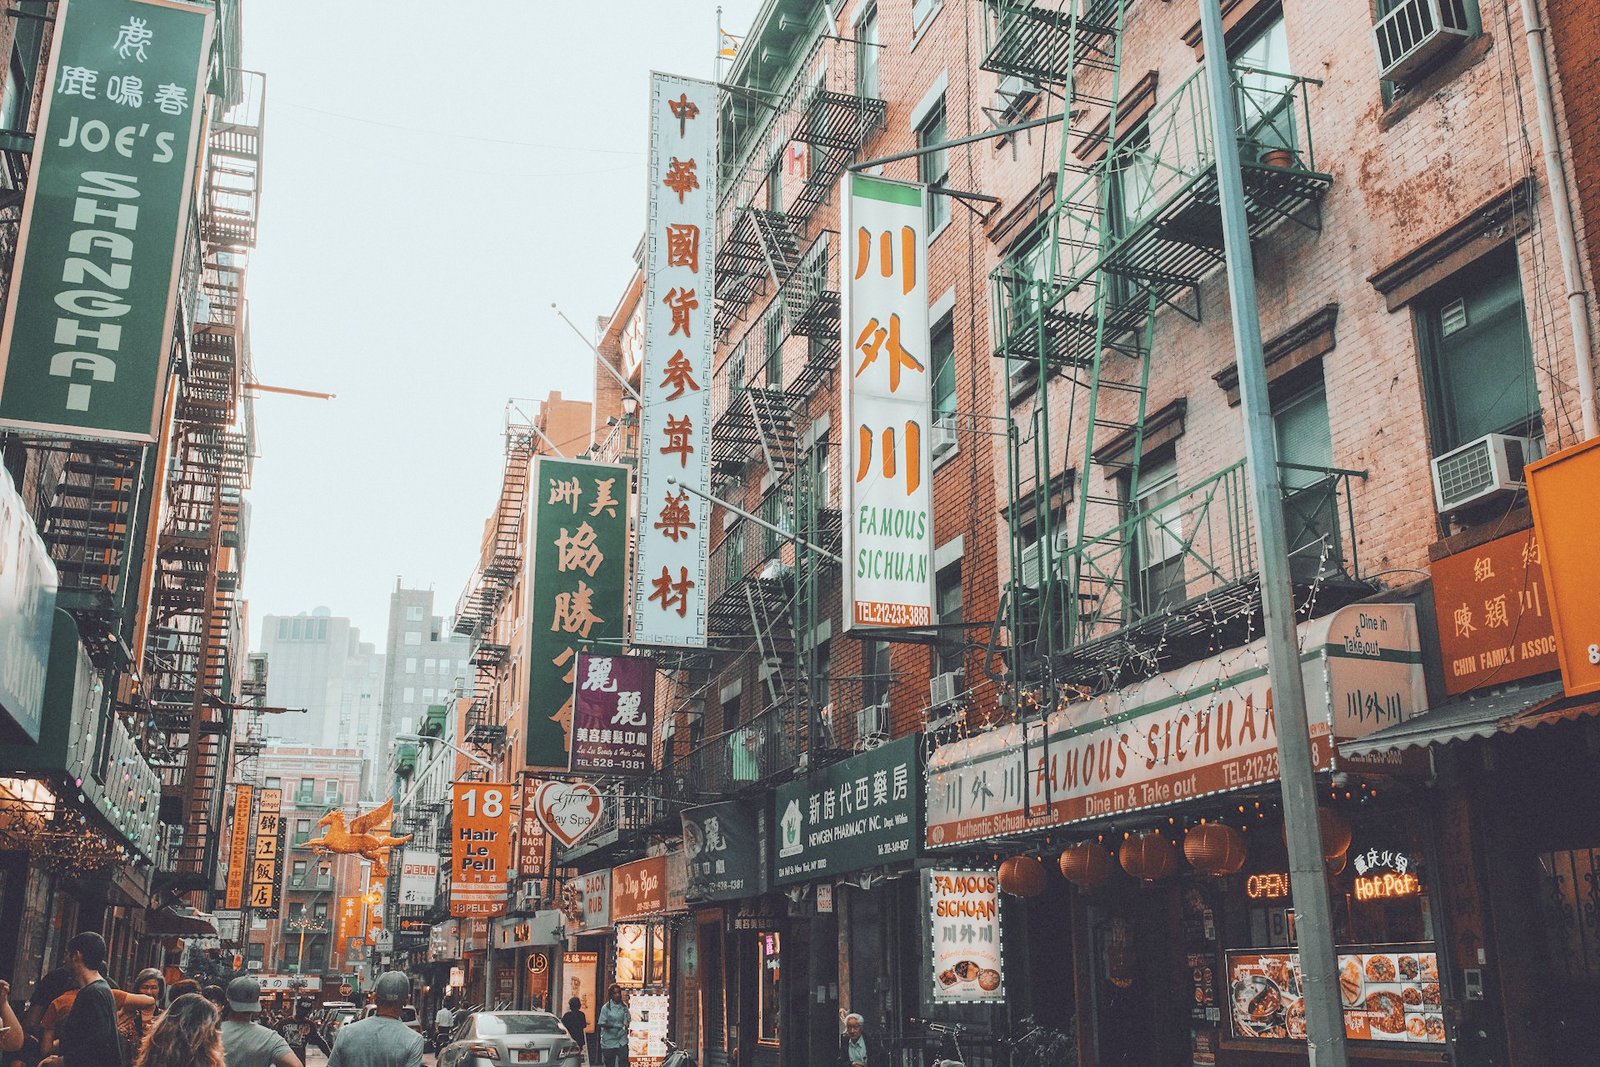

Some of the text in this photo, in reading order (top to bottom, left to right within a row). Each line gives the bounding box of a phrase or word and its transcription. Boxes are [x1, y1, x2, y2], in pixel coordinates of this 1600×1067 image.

[57, 65, 189, 117] 鹿鳴春
[58, 116, 175, 164] JOE'S
[49, 170, 142, 412] SHANGHAI
[854, 225, 924, 495] 川外川
[858, 505, 927, 541] FAMOUS
[857, 548, 928, 584] SICHUAN
[1355, 625, 1362, 638] &
[1359, 613, 1388, 631] Dine in
[1452, 635, 1557, 677] CHIN FAMILY ASSOC
[1346, 689, 1402, 724] 川外川
[1036, 733, 1129, 797] FAMOUS
[264, 791, 278, 800] Joe's
[809, 762, 908, 826] 新時代西藥房
[945, 760, 1023, 817] 川外川
[1085, 774, 1197, 816] Dine in & Take out
[261, 800, 280, 809] Ginger
[461, 788, 503, 818] 18
[546, 813, 591, 827] Day Spa
[955, 819, 993, 840] Authentic
[460, 828, 499, 841] Hair
[522, 837, 544, 846] BACK
[808, 828, 833, 847] NEWGEN
[834, 819, 867, 840] PHARMACY
[253, 815, 277, 905] 錦江飯店
[466, 843, 490, 857] Le
[521, 856, 543, 864] FOOT
[529, 847, 536, 856] &
[403, 864, 437, 876] PELL
[462, 857, 496, 872] Pell
[523, 865, 540, 873] RUB
[586, 874, 606, 894] BACK
[640, 869, 659, 899] Spa
[934, 876, 996, 897] FAMOUS
[1248, 873, 1288, 898] OPEN
[1355, 873, 1412, 900] Hot Pot
[466, 903, 490, 912] PELL
[491, 903, 504, 912] ST
[588, 896, 603, 914] RUB
[937, 898, 996, 921] SICHUAN
[942, 924, 993, 943] 川外川
